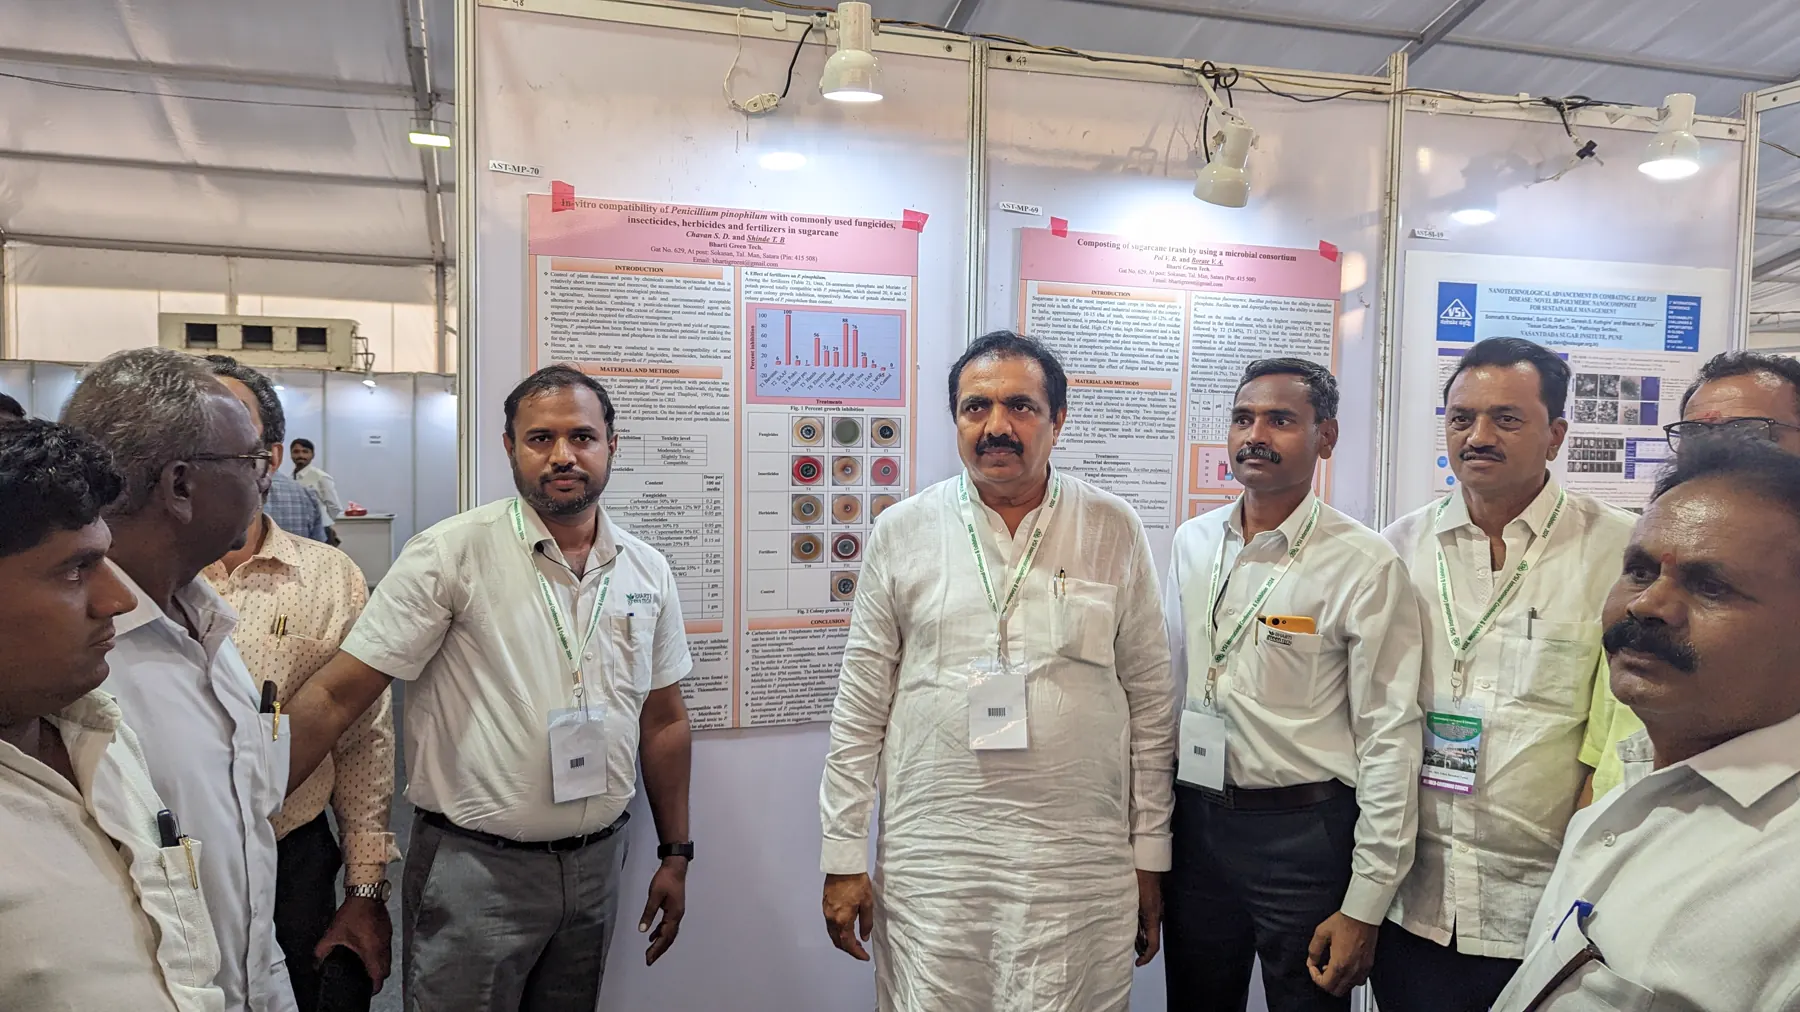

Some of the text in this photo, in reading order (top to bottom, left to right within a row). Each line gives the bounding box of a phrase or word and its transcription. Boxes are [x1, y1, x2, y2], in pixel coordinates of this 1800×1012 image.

[490, 161, 540, 175] AST-MP-70
[561, 198, 896, 229] In-vitro compatibility of Penicillium pinophilum with commonly used fungicides,
[1002, 203, 1038, 213] AST-MP-69
[628, 216, 680, 227] insecticides,
[682, 218, 726, 230] herbicides
[746, 224, 785, 233] fertilizers
[798, 229, 838, 237] sugarcane
[686, 231, 711, 239] Chavan
[747, 234, 770, 243] Shinde
[1078, 238, 1120, 249] Composting
[1131, 243, 1167, 252] sugarcane
[1225, 250, 1257, 258] microbial
[1489, 288, 1551, 296] NANOTECHNOLOGICAL
[1592, 300, 1637, 308] NANOCOMPOSITE
[1295, 520, 1313, 547] VSI International
[1514, 573, 1522, 582] VSI
[1499, 579, 1515, 602] International
[551, 605, 560, 628] Conference
[1221, 643, 1229, 652] VSI
[1227, 625, 1242, 646] International
[1240, 607, 1255, 627] Conference
[1256, 588, 1268, 606] Exhibition
[1266, 577, 1275, 588] 2024
[1485, 600, 1501, 622] Conference
